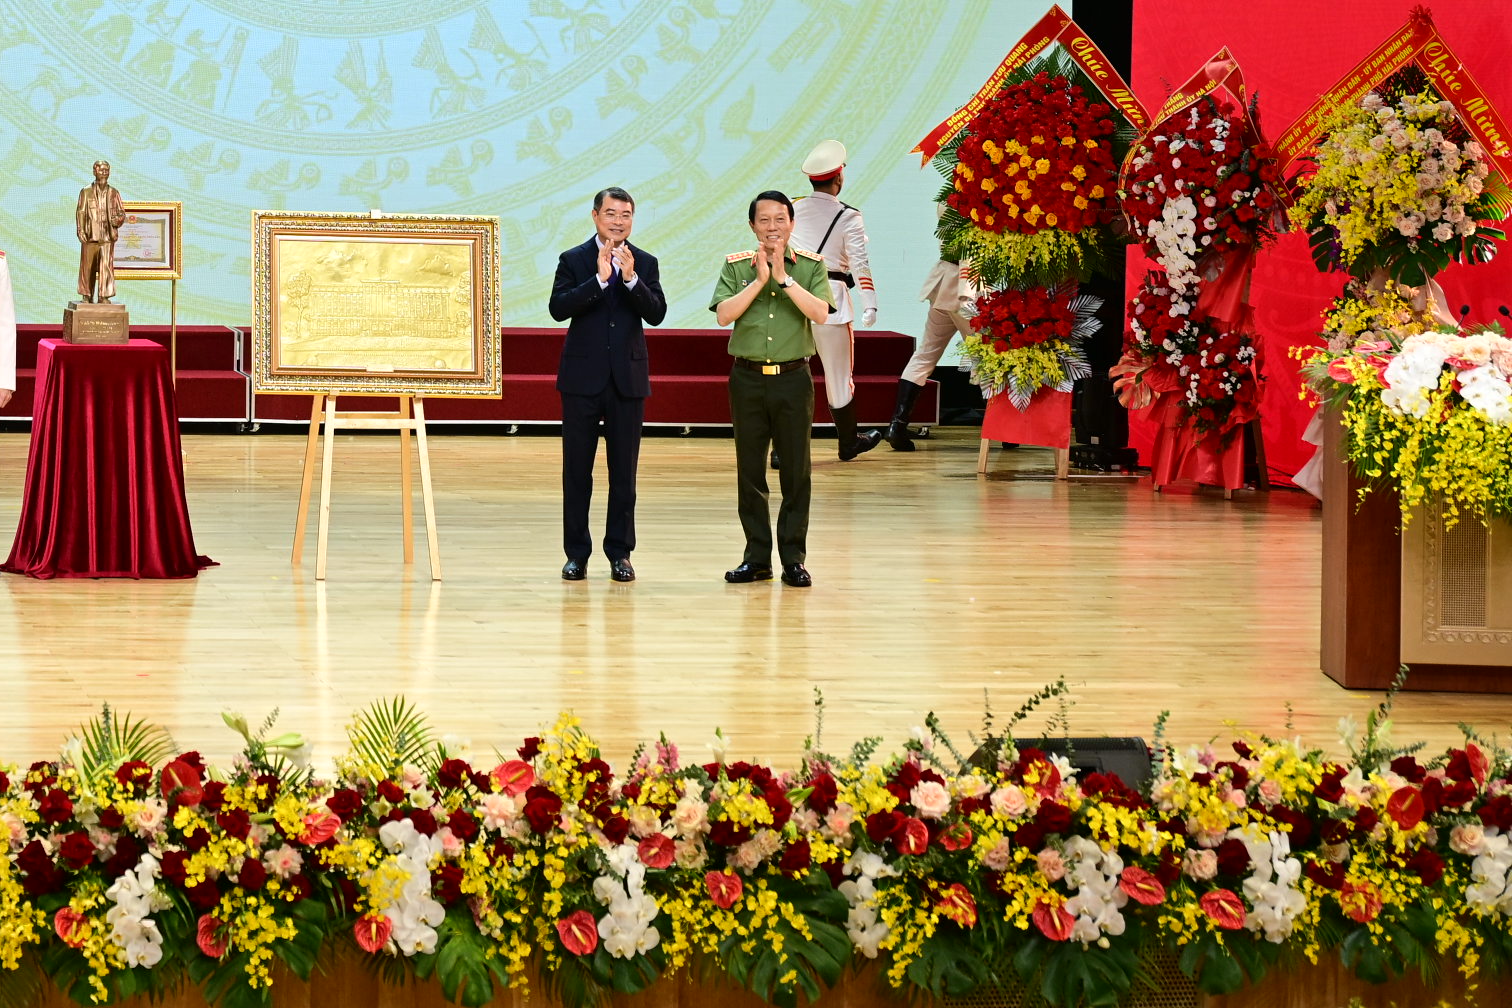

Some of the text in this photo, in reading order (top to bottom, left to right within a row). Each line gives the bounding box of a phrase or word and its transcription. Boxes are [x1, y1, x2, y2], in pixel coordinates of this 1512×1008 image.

[946, 106, 969, 129] ĐỒNG
[967, 96, 981, 111] CHÍ
[993, 64, 1007, 81] LƯU
[1004, 42, 1029, 67] QUANG
[1024, 36, 1050, 60] PHÒNG
[1070, 36, 1109, 78] Chúc
[1110, 87, 1145, 124] Mừn
[1347, 75, 1361, 89] DÂN
[1371, 53, 1386, 68] BAN
[1384, 39, 1403, 57] NHÂN
[1164, 99, 1186, 116] THÀNH
[1195, 88, 1206, 97] HÀ
[1296, 135, 1310, 149] BAN
[1369, 71, 1384, 85] PHỐ
[1382, 62, 1394, 74] HẢI
[1392, 45, 1414, 65] PHÒNG
[1423, 41, 1511, 157] Chúc Mừng
